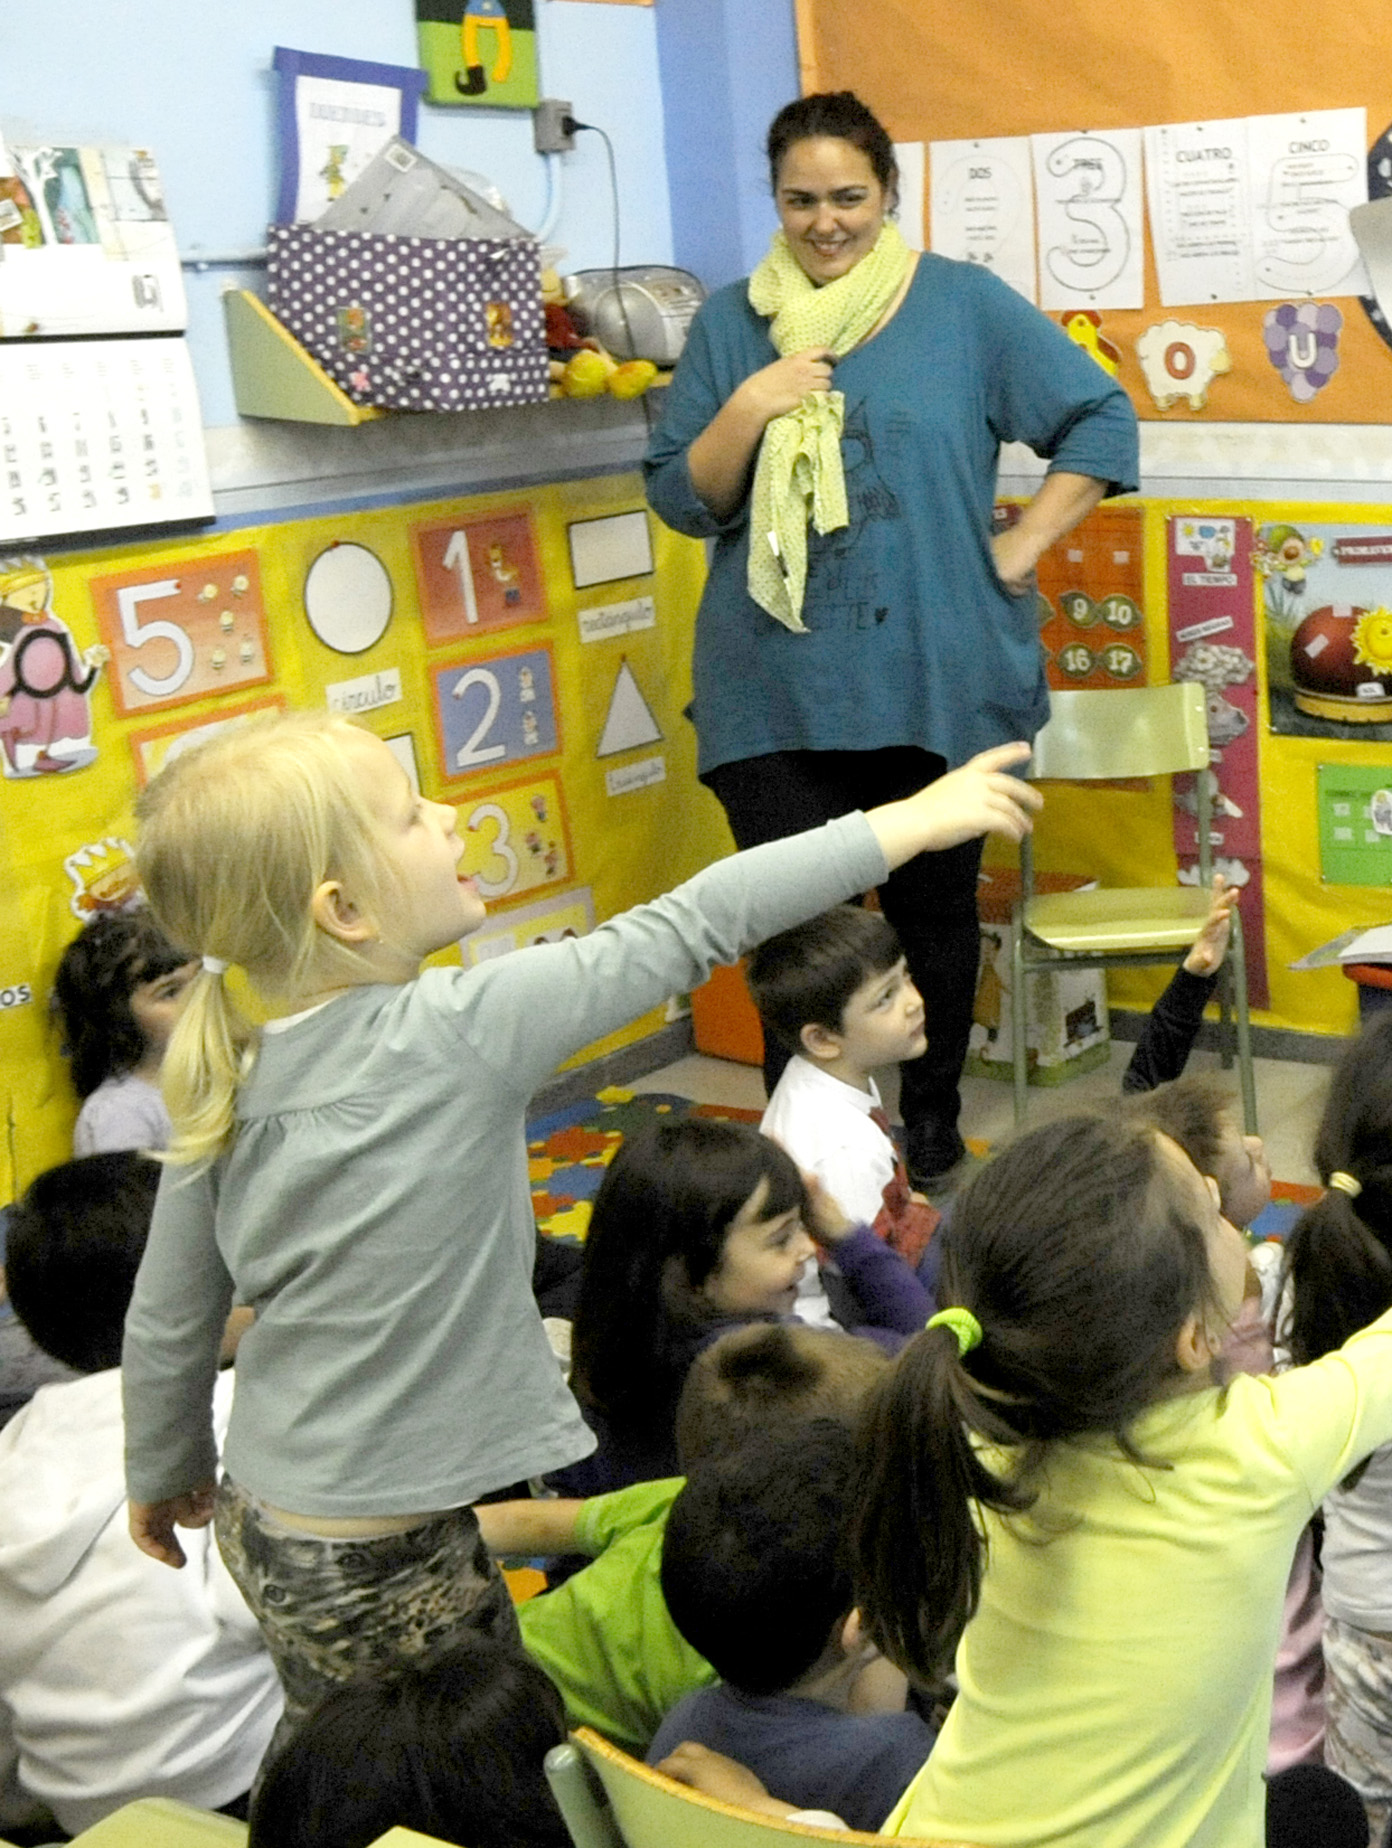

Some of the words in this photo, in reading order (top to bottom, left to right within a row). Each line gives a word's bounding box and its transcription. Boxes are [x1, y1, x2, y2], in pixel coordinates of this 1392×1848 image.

[1176, 147, 1233, 163] CUATRO
[1289, 139, 1330, 154] CINCO
[1164, 341, 1196, 380] O
[1289, 331, 1318, 369] U
[442, 529, 479, 624] 1
[1073, 599, 1088, 620] 9
[1106, 601, 1132, 625] 10
[117, 579, 195, 696] 5
[1064, 649, 1091, 672] 16
[1108, 650, 1133, 674] 17
[453, 668, 506, 768] 2
[468, 804, 519, 897] 3
